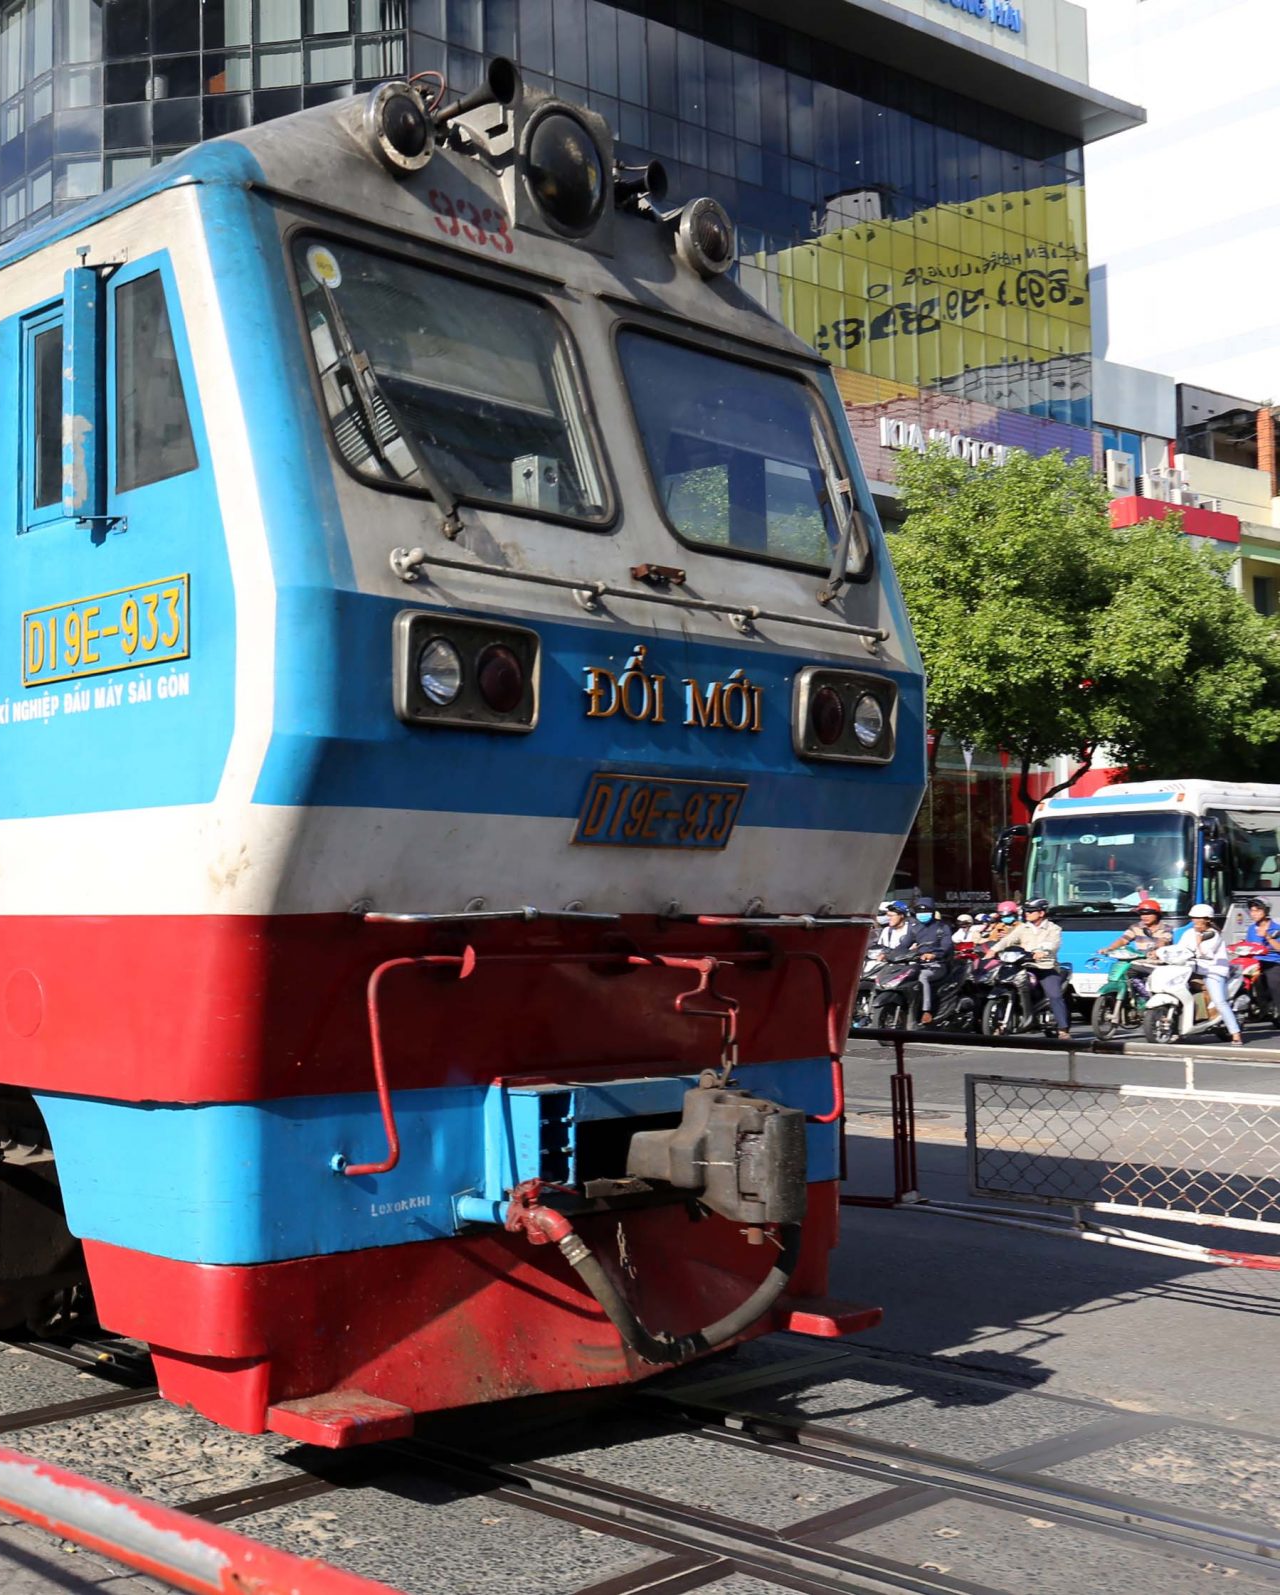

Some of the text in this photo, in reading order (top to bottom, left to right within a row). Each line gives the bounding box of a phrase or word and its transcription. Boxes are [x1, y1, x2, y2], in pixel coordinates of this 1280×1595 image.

[880, 416, 926, 455] KIA
[27, 588, 182, 674] D19E-933
[12, 690, 60, 725] NGHIỆP
[94, 678, 124, 710] MÁY
[157, 668, 190, 699] GÒN
[583, 645, 764, 732] ĐỔI MỚI
[583, 783, 739, 842] D19E-933
